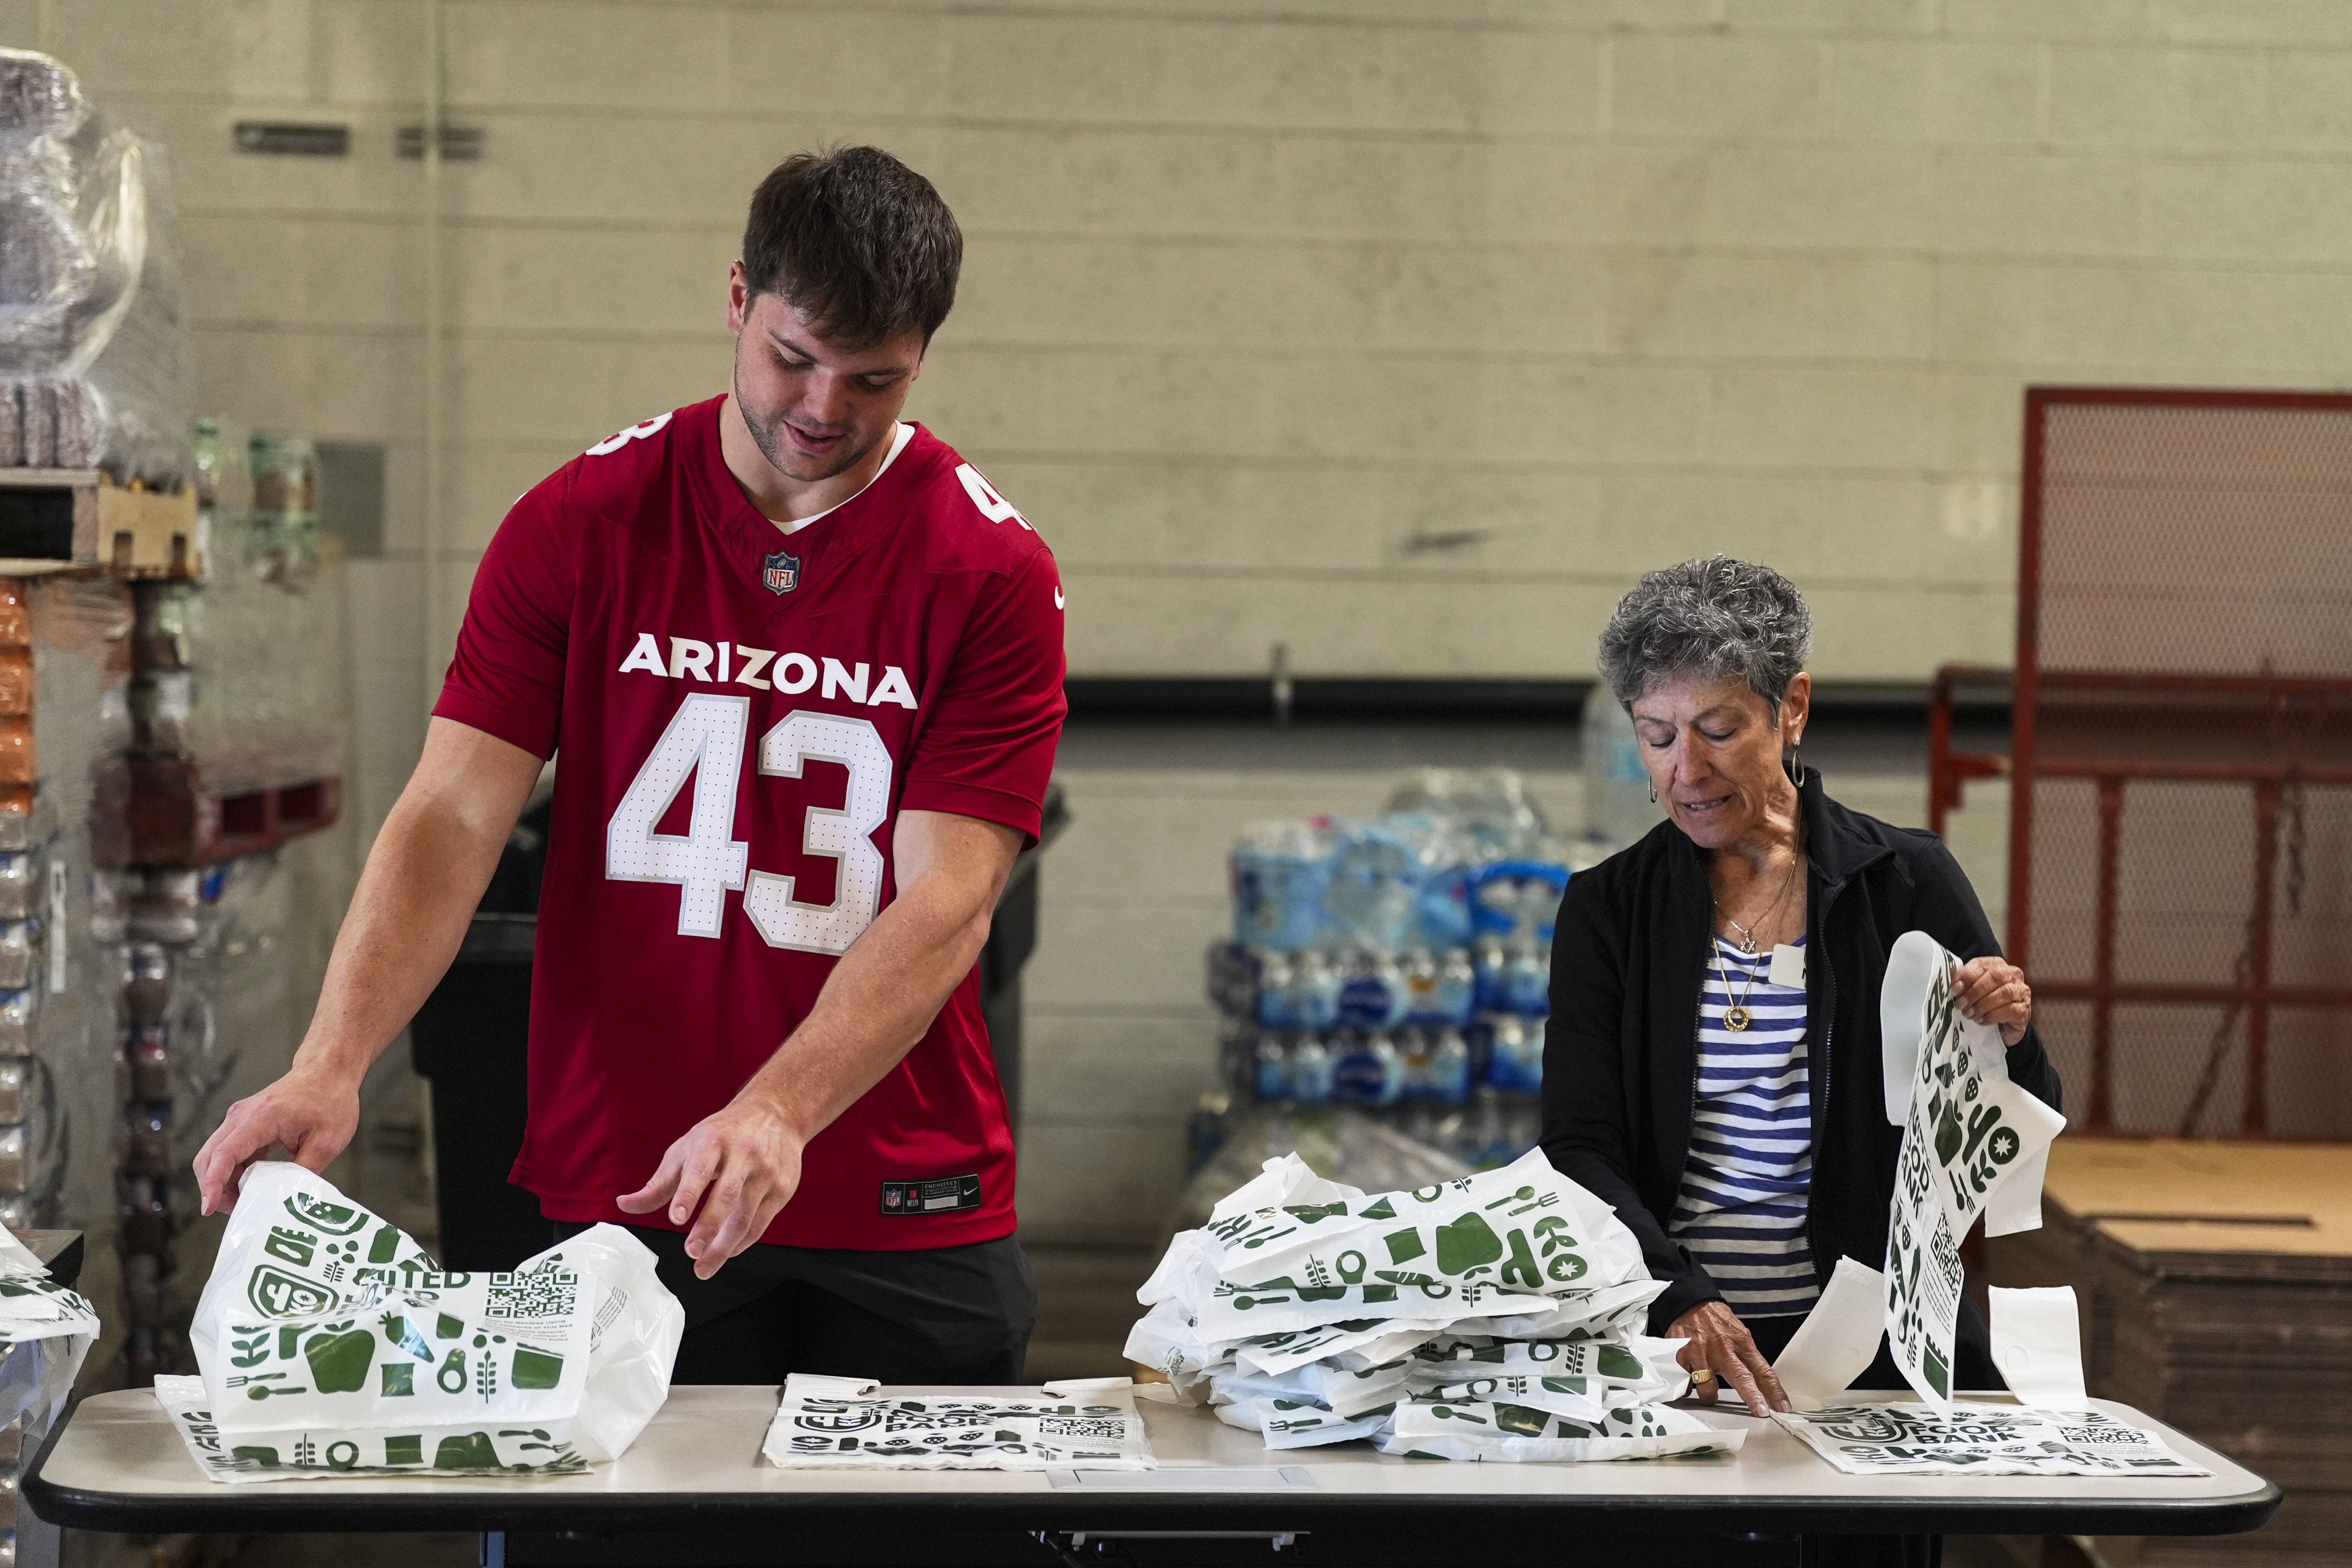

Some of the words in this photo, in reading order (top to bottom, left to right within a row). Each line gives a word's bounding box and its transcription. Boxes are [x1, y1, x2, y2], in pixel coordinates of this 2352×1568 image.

[769, 570, 792, 588] NFL
[618, 633, 918, 710] ARIZONA
[605, 692, 893, 956] 43
[1906, 1123, 1929, 1192] OOD
[925, 1180, 957, 1189] ENGINEERED
[1902, 1151, 1923, 1220] ANK
[888, 1197, 899, 1205] NFL
[1908, 1425, 2016, 1435] FOOD
[1915, 1432, 2026, 1444] BANK
